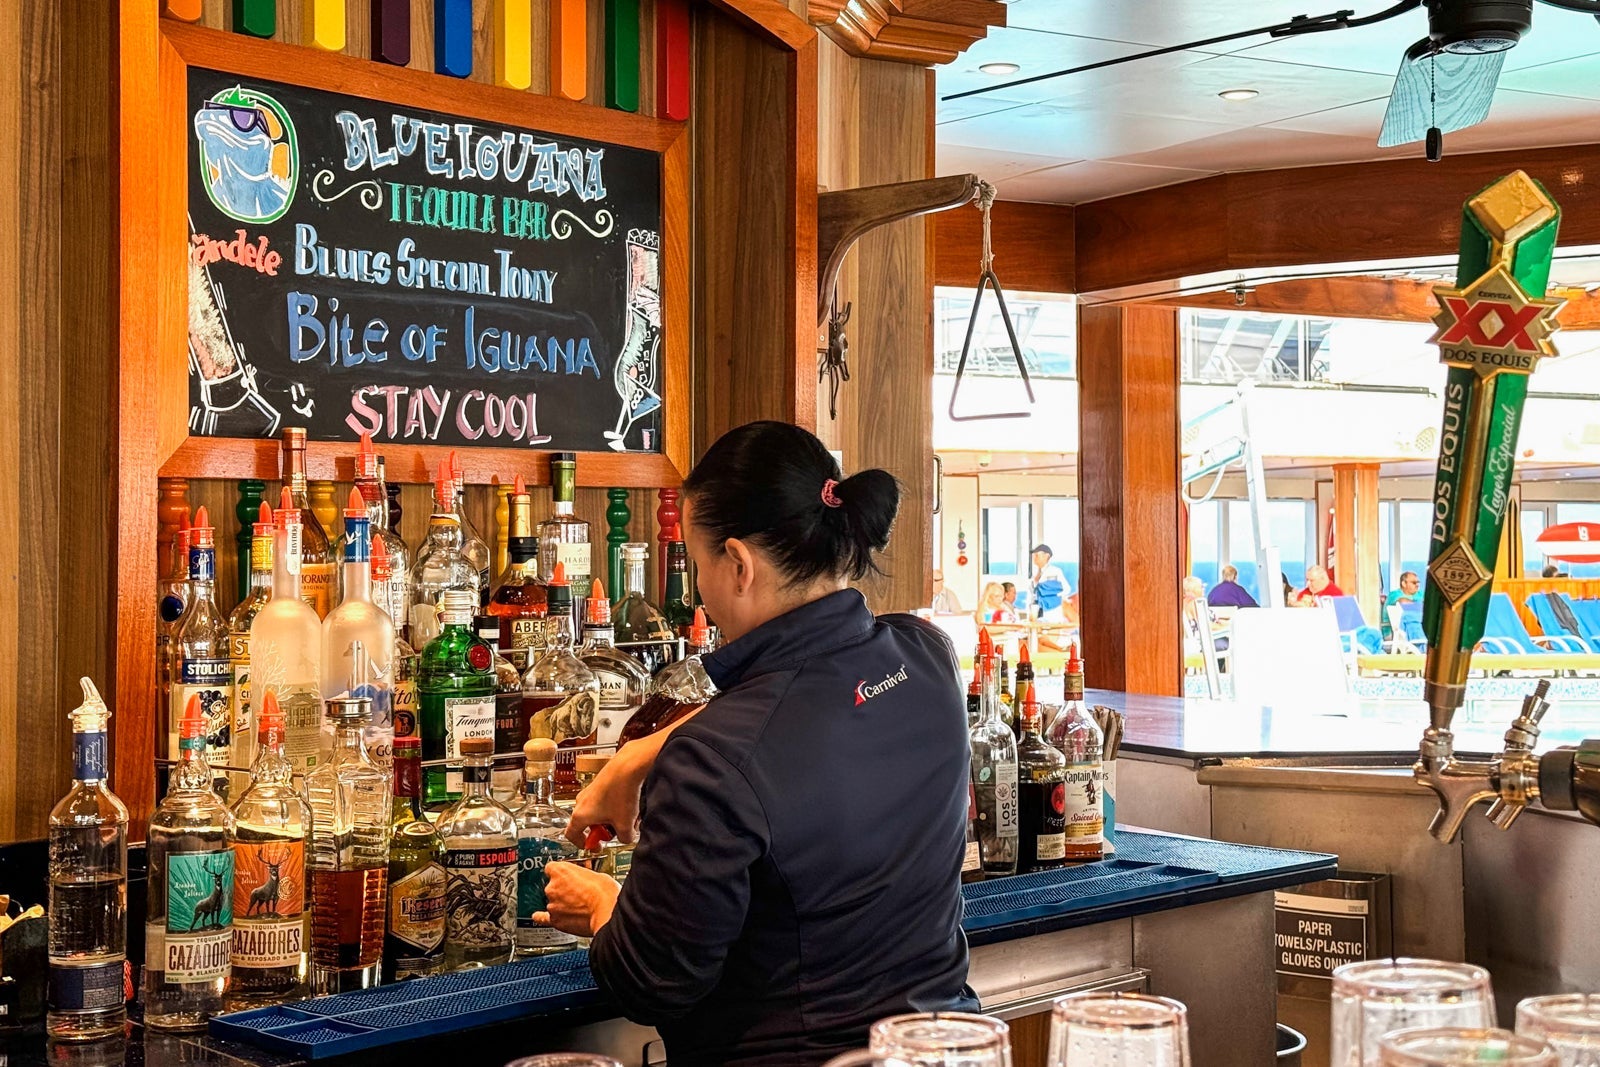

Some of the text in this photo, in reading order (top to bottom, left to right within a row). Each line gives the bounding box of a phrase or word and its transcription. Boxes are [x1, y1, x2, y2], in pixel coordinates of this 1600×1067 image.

[384, 183, 552, 240] TEQUILA BAR
[464, 304, 601, 380] IGUANA
[1443, 348, 1532, 369] DOS EQUIS
[344, 384, 552, 446] STAY COOL
[1433, 383, 1464, 543] DOS EQUIS
[1482, 404, 1516, 525] Lager Especial
[1442, 569, 1473, 581] 1897
[864, 666, 908, 698] Carnival
[1064, 770, 1091, 785] Captain
[1002, 802, 1010, 827] LOS
[1071, 812, 1094, 823] Spiced
[195, 935, 221, 944] TEQUILA
[1298, 920, 1332, 936] PAPER
[232, 928, 300, 956] CAZADORES
[169, 940, 232, 971] CAZADORE
[1282, 951, 1322, 969] GLOVES
[196, 968, 220, 977] BLANCO
